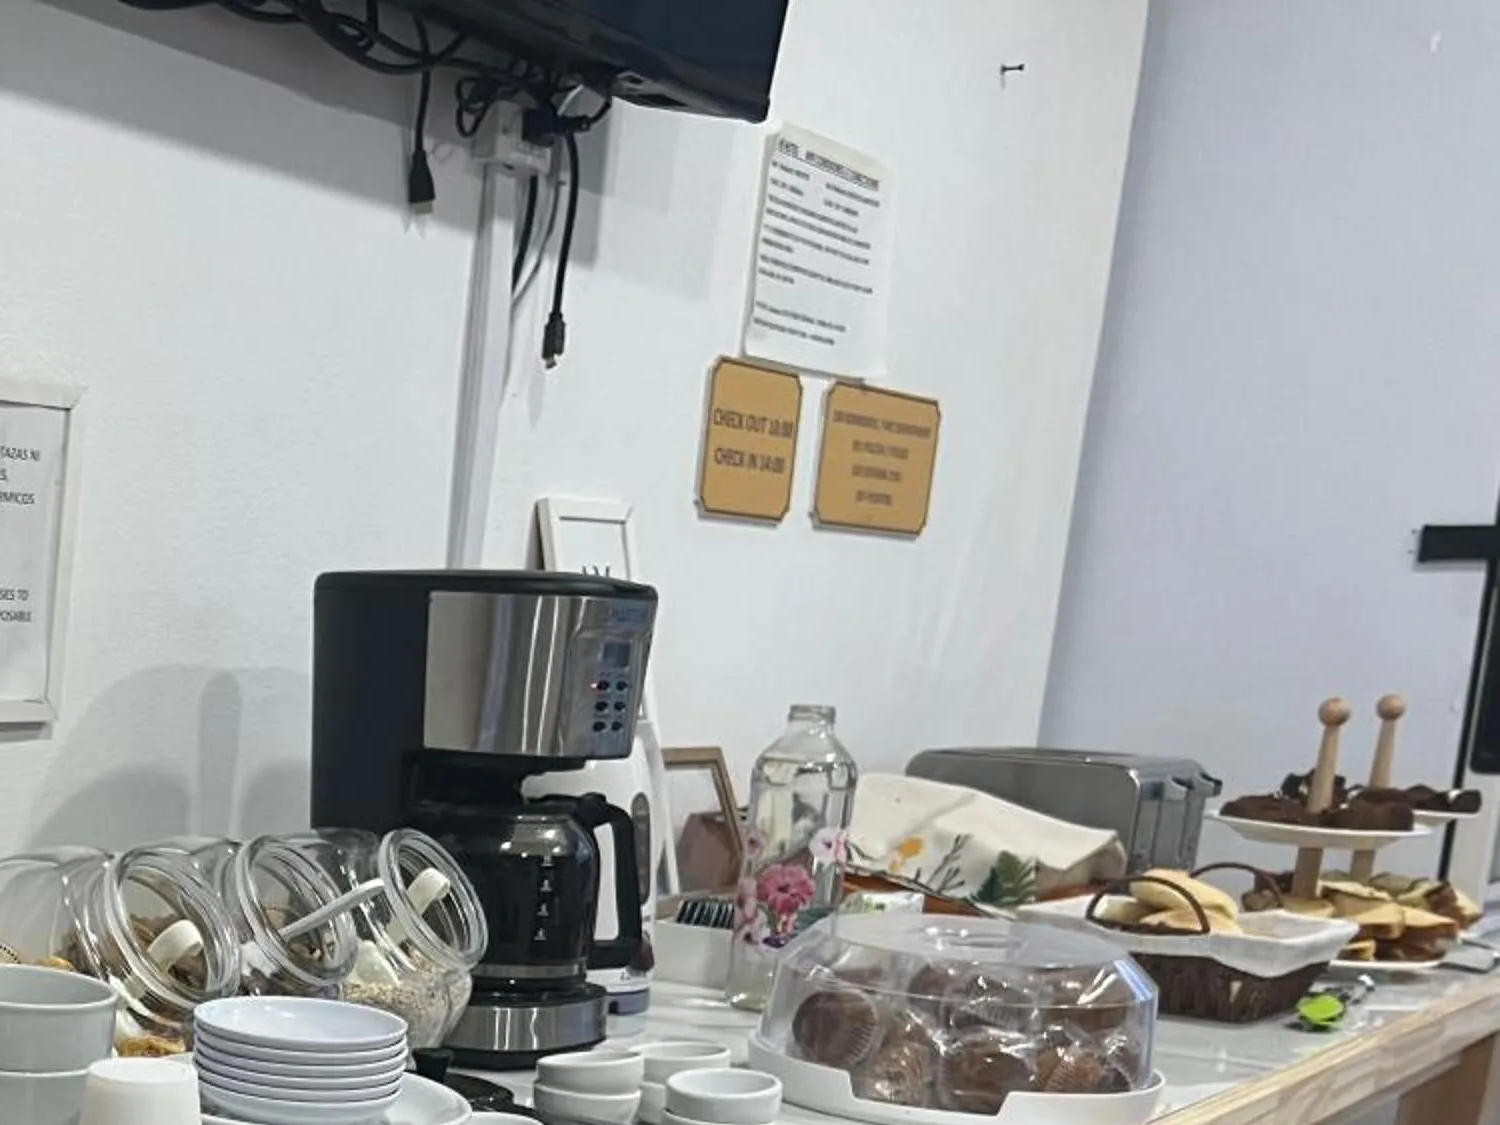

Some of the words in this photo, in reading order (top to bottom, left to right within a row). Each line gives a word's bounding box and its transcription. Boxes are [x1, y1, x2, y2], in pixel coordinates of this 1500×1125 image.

[714, 408, 743, 430] CHECK
[746, 414, 768, 434] OUT
[0, 446, 29, 460] TAZAS
[714, 448, 744, 467] CHECK
[747, 453, 758, 470] IN
[17, 589, 30, 601] TO
